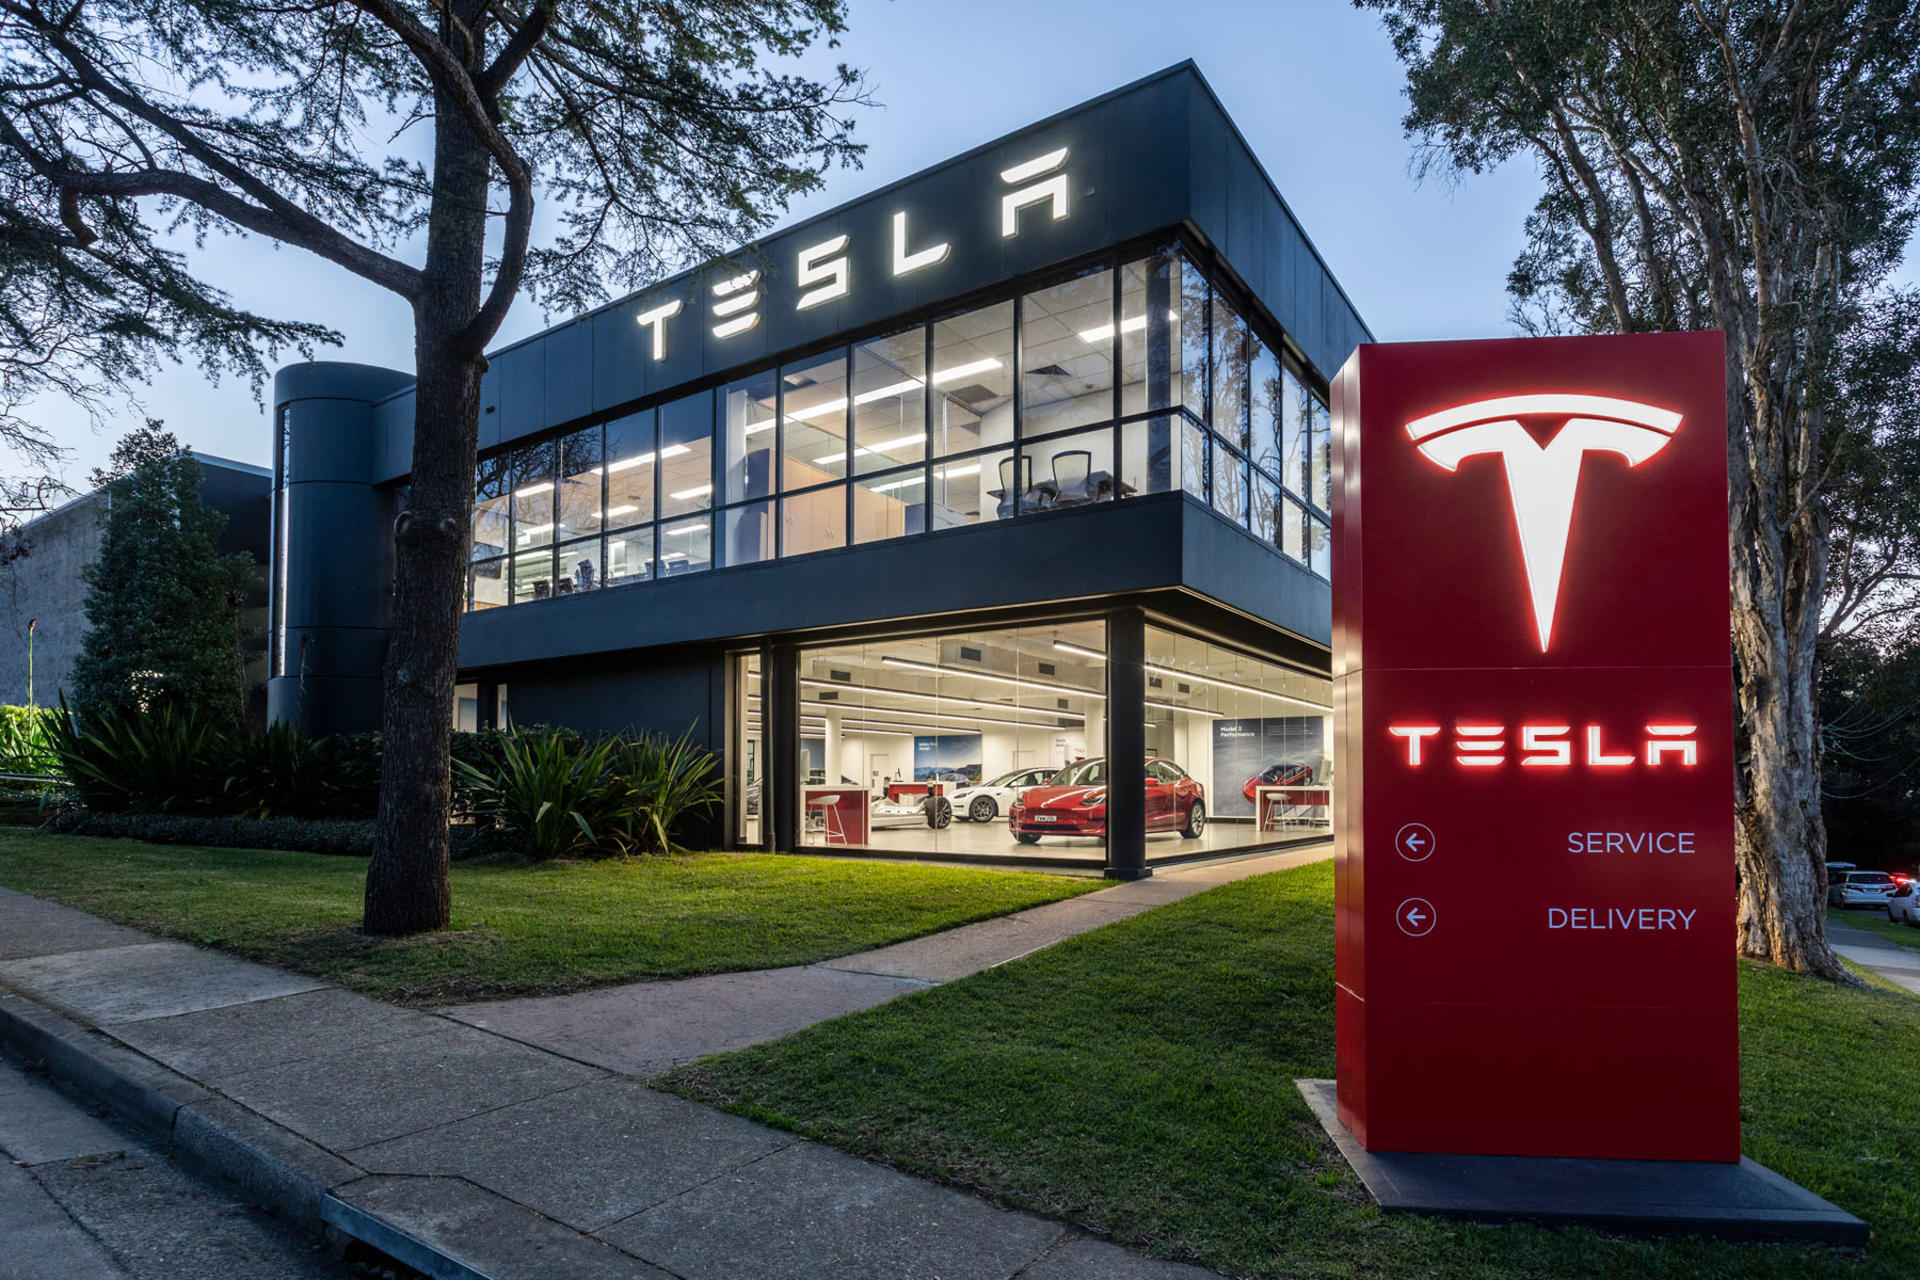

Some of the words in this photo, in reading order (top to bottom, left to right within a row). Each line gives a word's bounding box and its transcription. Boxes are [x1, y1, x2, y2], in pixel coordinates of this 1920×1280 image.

[637, 147, 1070, 362] TESLA
[1388, 725, 1698, 766] TESLA
[1567, 832, 1696, 854] SERVICE
[1548, 908, 1697, 930] DELIVERY
